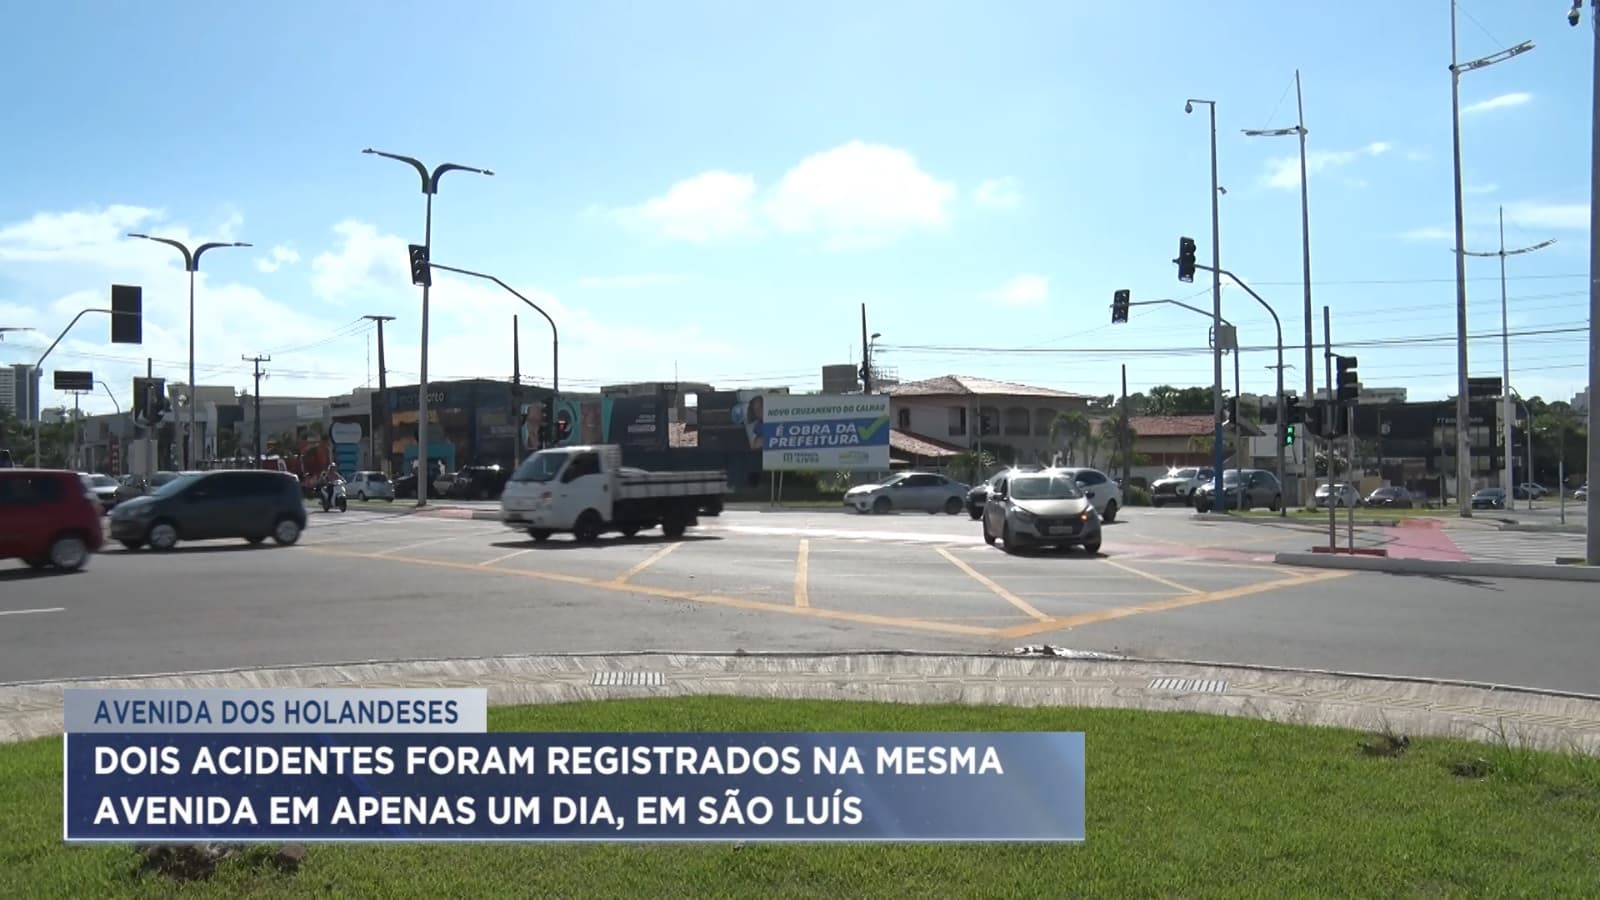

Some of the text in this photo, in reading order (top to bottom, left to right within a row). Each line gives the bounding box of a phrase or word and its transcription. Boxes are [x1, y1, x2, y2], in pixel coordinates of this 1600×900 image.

[768, 408, 790, 417] NOVO
[791, 406, 842, 415] CRUZAMENTO
[856, 404, 886, 412] CALHAU
[776, 423, 857, 436] É OBRA DA
[769, 434, 860, 448] PREFEITURA
